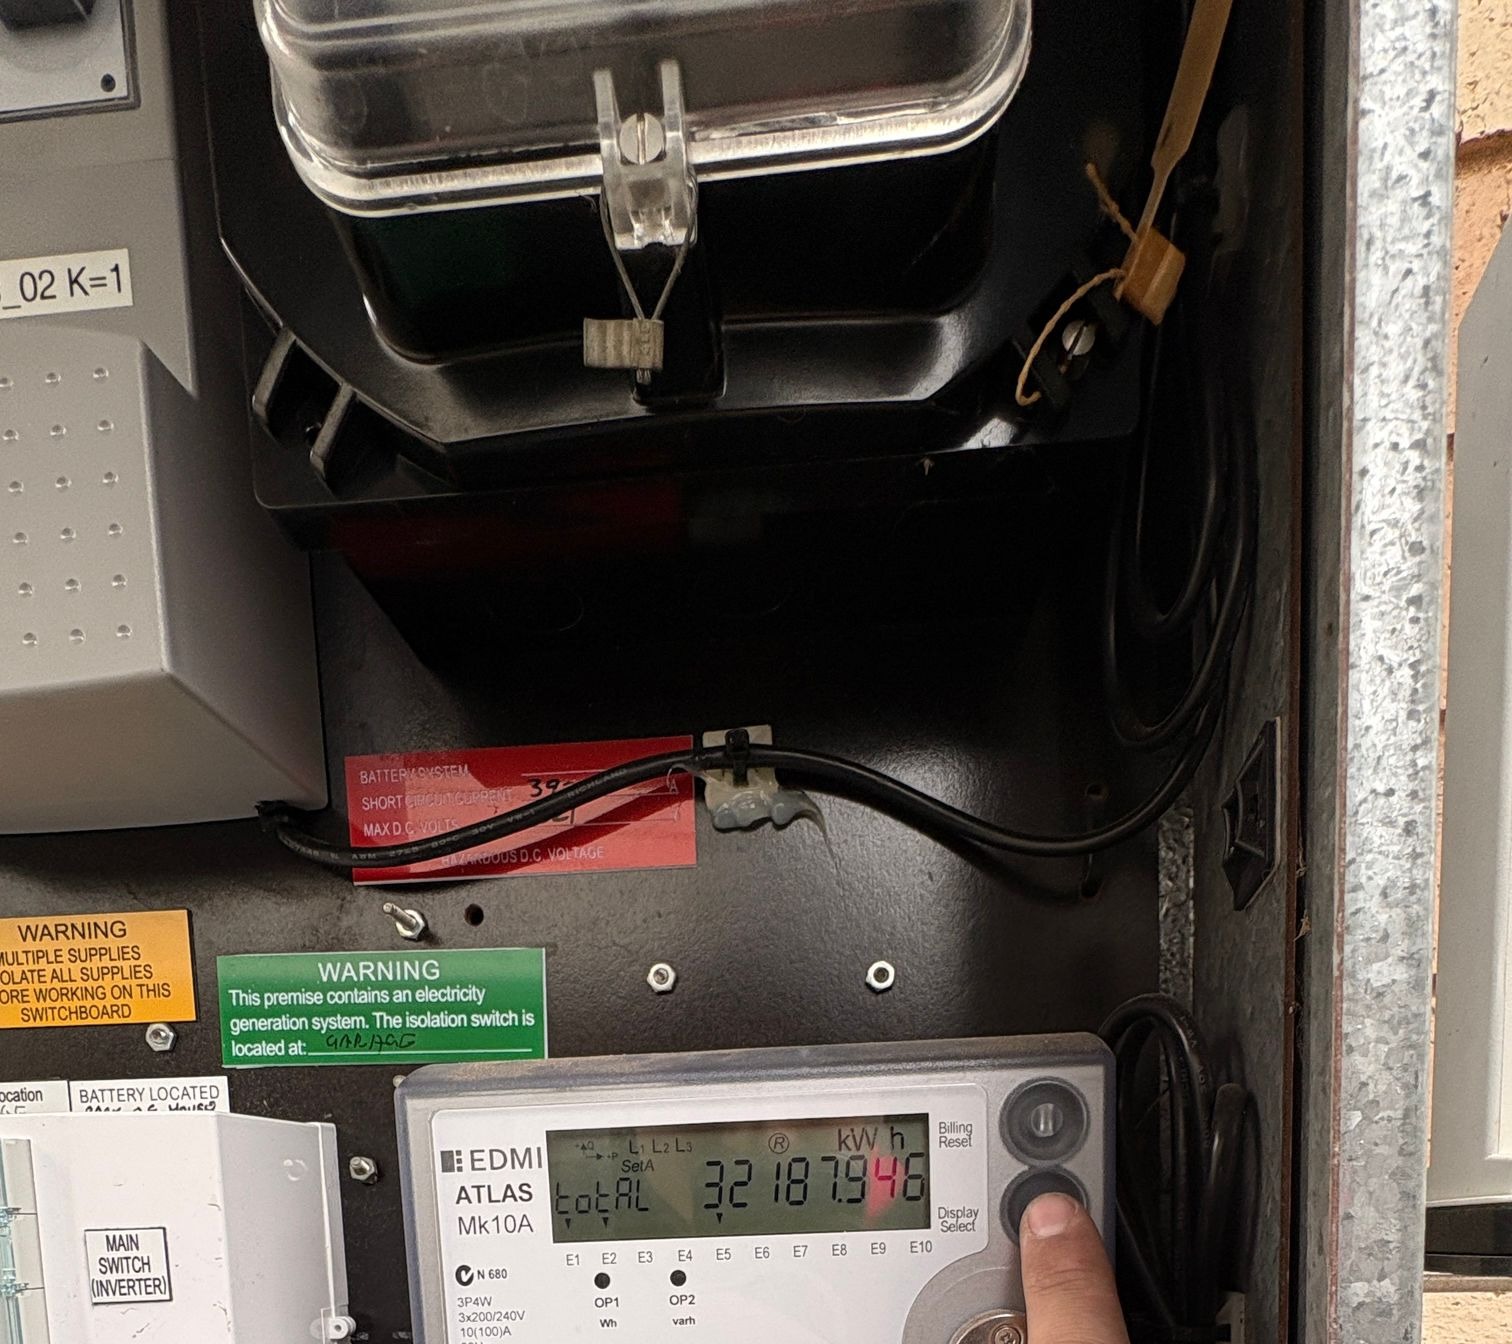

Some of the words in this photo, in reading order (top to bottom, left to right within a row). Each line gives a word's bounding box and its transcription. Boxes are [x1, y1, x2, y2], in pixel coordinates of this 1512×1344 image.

[0, 269, 57, 310] _02
[67, 263, 122, 297] K=1
[359, 769, 415, 784] BATTERY
[362, 795, 404, 811] SHORT
[363, 822, 391, 837] MAX
[548, 846, 606, 861] VOLTAGE
[18, 920, 127, 942] WARNING
[68, 945, 141, 963] SUPPLIES
[50, 967, 77, 983] ALL
[80, 964, 153, 982] SUPPLIES
[318, 960, 440, 982] WARNING
[33, 985, 106, 1003] WORKING
[111, 984, 133, 1000] ON
[137, 983, 171, 999] THIS
[228, 989, 260, 1006] This
[264, 988, 323, 1009] premise
[327, 986, 389, 1004] contains
[393, 989, 412, 1003] an
[415, 985, 485, 1005] electricity
[21, 1004, 131, 1023] SWITCHBOARD
[230, 1014, 308, 1035] generation
[312, 1014, 369, 1034] system.
[372, 1012, 402, 1029] The
[406, 1011, 467, 1028] isolation
[471, 1010, 518, 1027] switch
[522, 1009, 535, 1026] is
[231, 1040, 284, 1057] located
[288, 1040, 307, 1056] at:
[80, 1088, 145, 1103] BATTERY
[149, 1085, 219, 1101] LOCATED
[939, 1121, 973, 1136] Billing
[939, 1135, 972, 1148] Reset
[470, 1147, 542, 1171] EDMI
[455, 1183, 533, 1204] ATLAS
[938, 1206, 979, 1221] Display
[458, 1214, 534, 1235] Mk10A
[940, 1219, 976, 1233] Select
[105, 1233, 139, 1252] MAIN
[566, 1254, 580, 1266] E1
[602, 1253, 617, 1265] E2
[638, 1251, 653, 1263] E3
[678, 1250, 693, 1262] E4
[716, 1248, 731, 1260] E5
[755, 1246, 770, 1259] E6
[793, 1245, 808, 1257] E7
[832, 1243, 847, 1256] E8
[870, 1242, 886, 1255] E9
[910, 1240, 932, 1253] E10
[98, 1256, 151, 1275] SWITCH
[477, 1269, 485, 1280] N
[488, 1268, 508, 1279] 680
[91, 1275, 167, 1298] (INVERTER)
[457, 1296, 492, 1308] 3P4W
[594, 1297, 619, 1308] OP1
[669, 1294, 696, 1306] OP2
[458, 1310, 525, 1322] 3x200/240V
[600, 1319, 617, 1328] Wh
[672, 1316, 696, 1326] varh
[461, 1326, 512, 1339] 10(100)A
